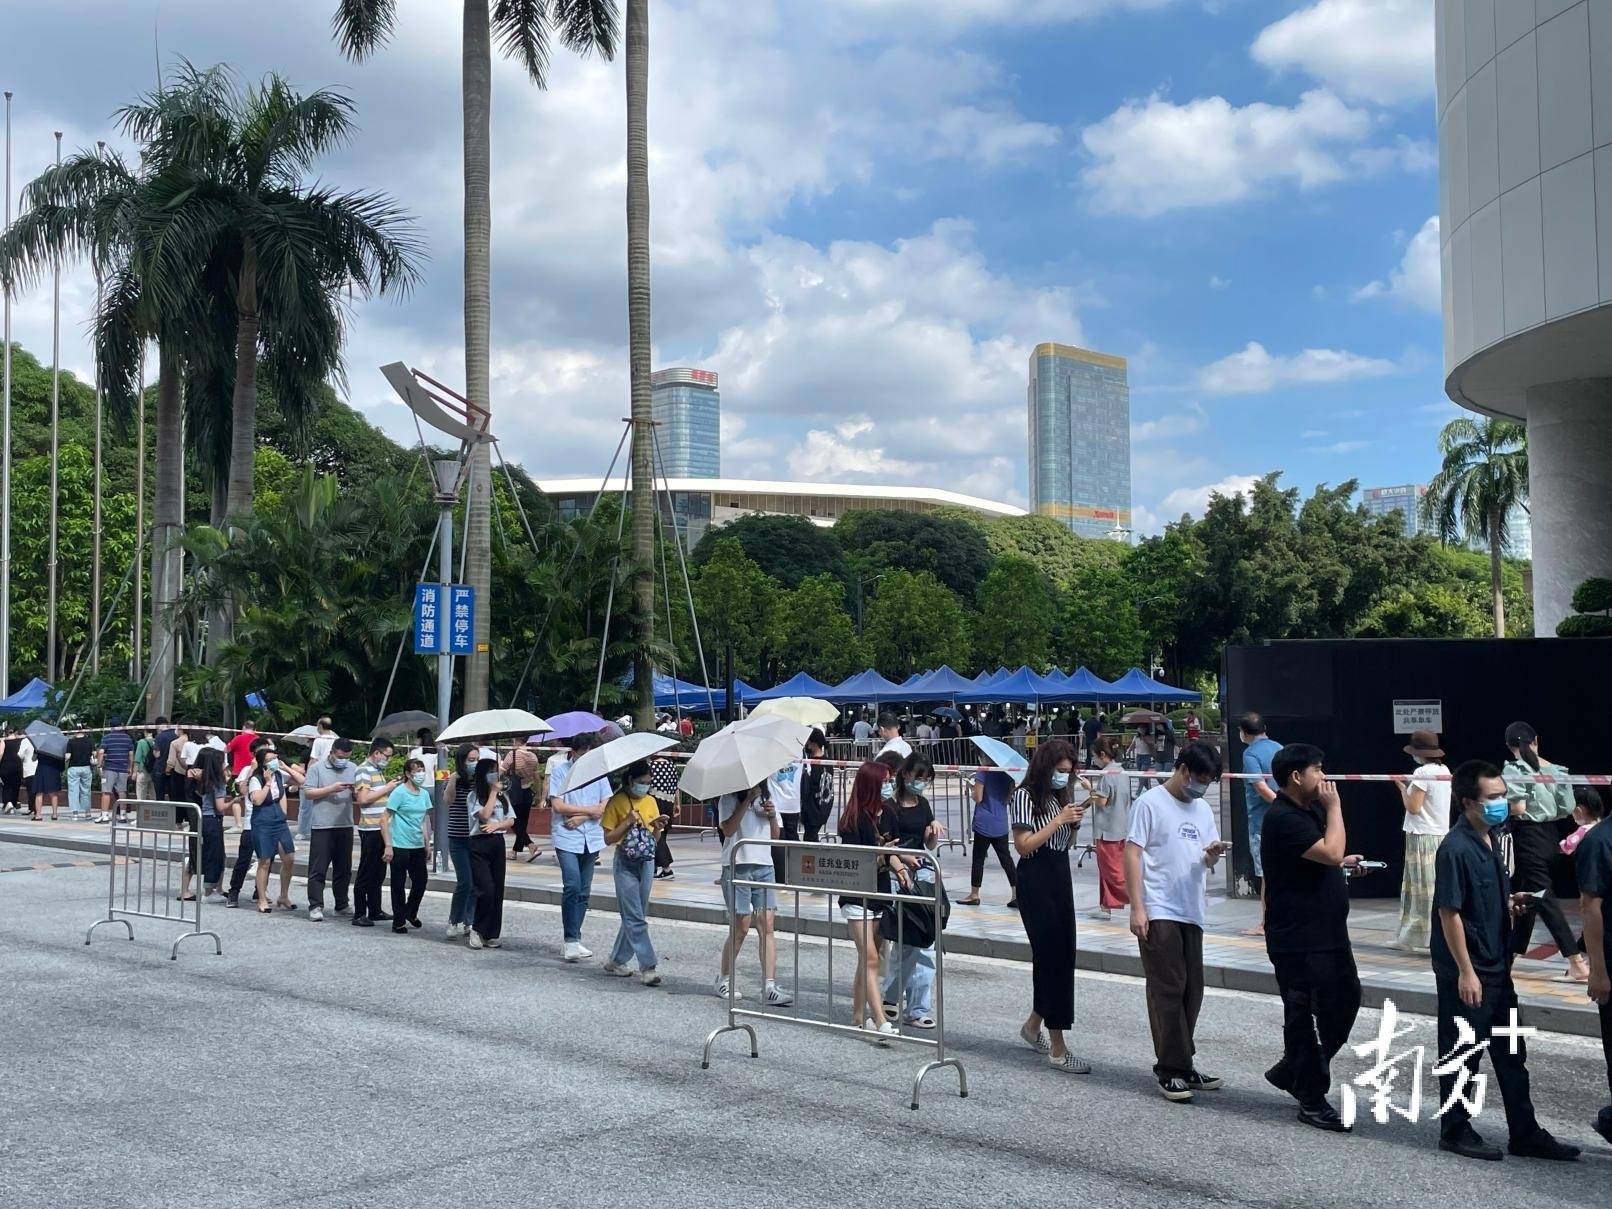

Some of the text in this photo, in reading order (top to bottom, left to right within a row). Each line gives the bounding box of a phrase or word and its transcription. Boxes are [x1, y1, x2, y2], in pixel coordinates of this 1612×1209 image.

[420, 588, 436, 648] 消防通道
[454, 589, 470, 648] 严禁停车
[818, 857, 859, 870] 佳兆业美好
